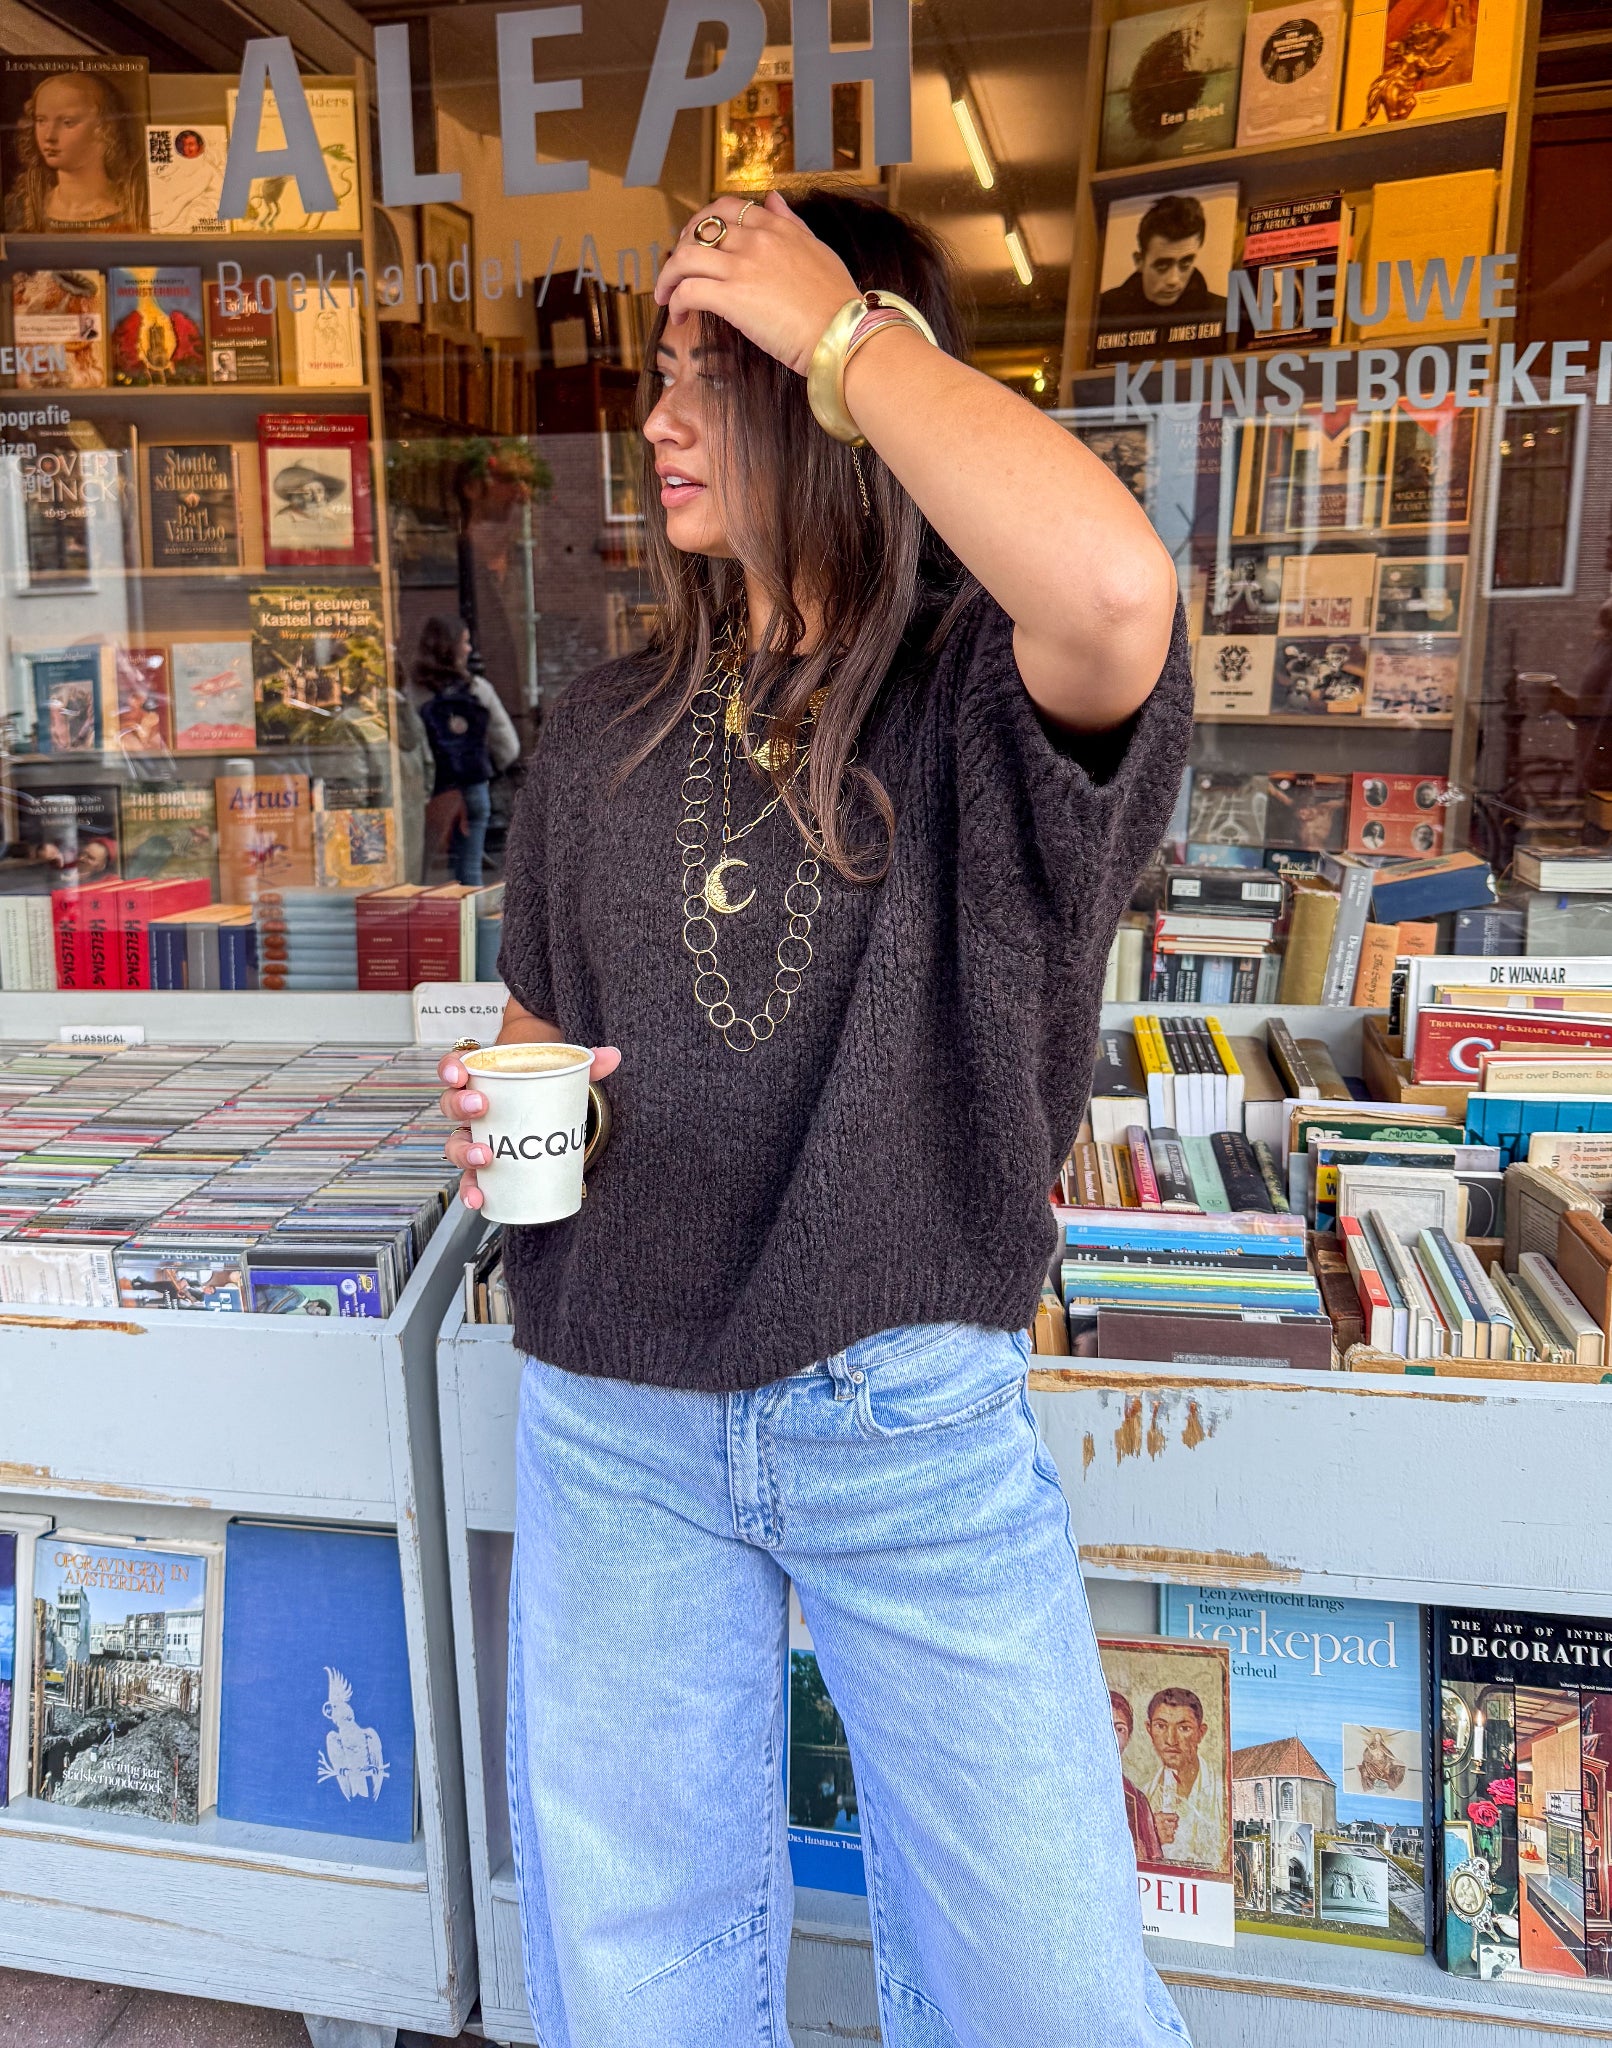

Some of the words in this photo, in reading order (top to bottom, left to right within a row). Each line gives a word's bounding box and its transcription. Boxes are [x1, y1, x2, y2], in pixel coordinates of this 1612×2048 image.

[218, 0, 913, 219] ALEPH
[1250, 207, 1291, 222] GENERAL
[1292, 200, 1334, 215] HISTORY
[1249, 222, 1263, 233] OF
[1263, 216, 1297, 230] AFRICA
[1225, 253, 1518, 333] NIEUWE
[1097, 332, 1127, 349] DENNIS
[1128, 328, 1157, 347] STOCK
[1168, 325, 1197, 342] JAMES
[1198, 321, 1222, 340] DEAN
[1, 344, 67, 375] EKEN
[17, 450, 123, 477] GOVERT
[164, 449, 217, 474] Stoute
[154, 471, 228, 491] schoenen
[178, 504, 209, 528] Bart
[165, 519, 194, 542] Van
[197, 517, 225, 542] Loo
[280, 596, 311, 611] Tien
[313, 599, 370, 611] eeuwen
[261, 611, 312, 627] Kasteel
[313, 611, 333, 627] de
[337, 610, 372, 627] Haar
[130, 793, 154, 806] THE
[159, 792, 187, 805] GIRL
[229, 785, 300, 811] Artusi
[131, 807, 155, 821] THE
[160, 807, 202, 820] GRASS
[59, 919, 77, 987] HELLSING
[89, 918, 107, 987] HELLSING
[123, 919, 141, 987] HELLSING
[1490, 966, 1504, 983] DE
[1508, 966, 1566, 984] WINNAAR
[421, 1005, 441, 1014] ALL
[444, 1005, 466, 1014] CDS
[470, 1005, 499, 1016] €2,50
[71, 1033, 126, 1043] CLASSICAL
[1429, 1019, 1498, 1031] TROUBADOURS
[1505, 1024, 1550, 1036] ECKHART
[1558, 1029, 1603, 1039] ALCHEMY
[1494, 1072, 1523, 1080] Kunst
[1552, 1070, 1593, 1079] Bomen:
[54, 1551, 166, 1578] OPGRAVINGEN
[171, 1563, 190, 1582] IN
[64, 1569, 166, 1595] AMSTERDAM
[1199, 1586, 1226, 1600] Een
[1307, 1594, 1345, 1614] langs
[1199, 1600, 1225, 1616] tien
[1226, 1602, 1253, 1620] jaar
[1451, 1620, 1481, 1632] THE
[1494, 1623, 1523, 1635] ART
[1534, 1627, 1554, 1637] OF
[1185, 1603, 1400, 1677] kerkepad
[1231, 1659, 1277, 1679] erheul
[103, 1759, 140, 1780] twintig
[141, 1763, 162, 1780] jaar
[62, 1768, 164, 1795] stadskernonderzoek
[1137, 1876, 1199, 1915] PEII
